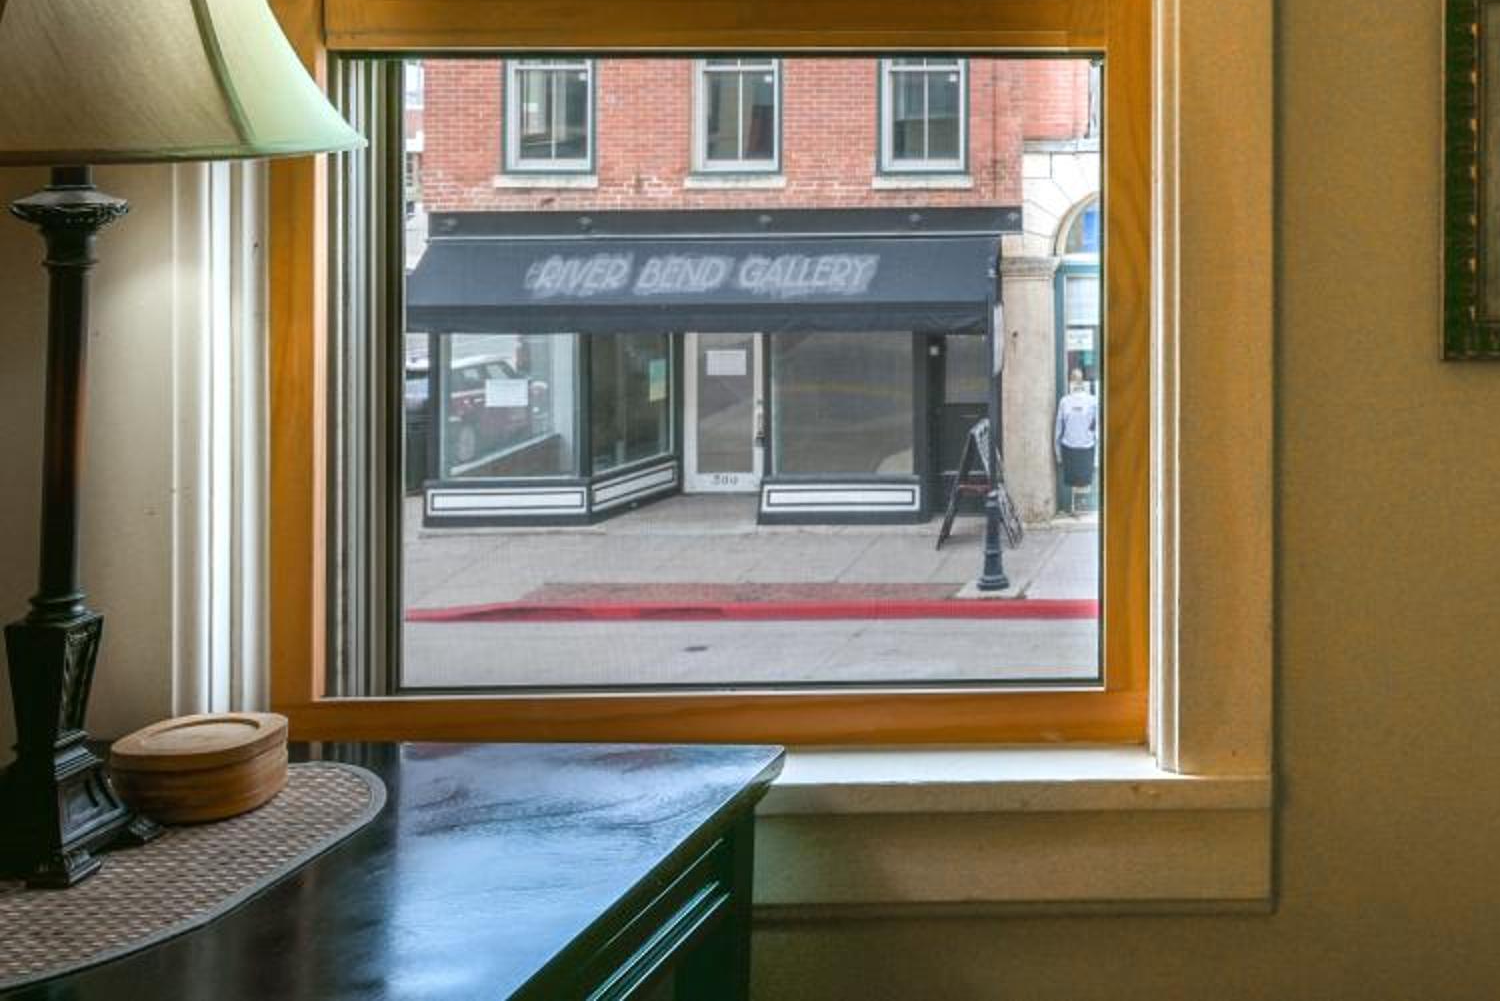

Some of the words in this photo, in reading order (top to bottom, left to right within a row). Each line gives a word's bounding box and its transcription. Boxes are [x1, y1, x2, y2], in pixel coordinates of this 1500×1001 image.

[529, 255, 633, 296] RIVER
[634, 256, 734, 294] BEND
[738, 255, 879, 295] GALLERY
